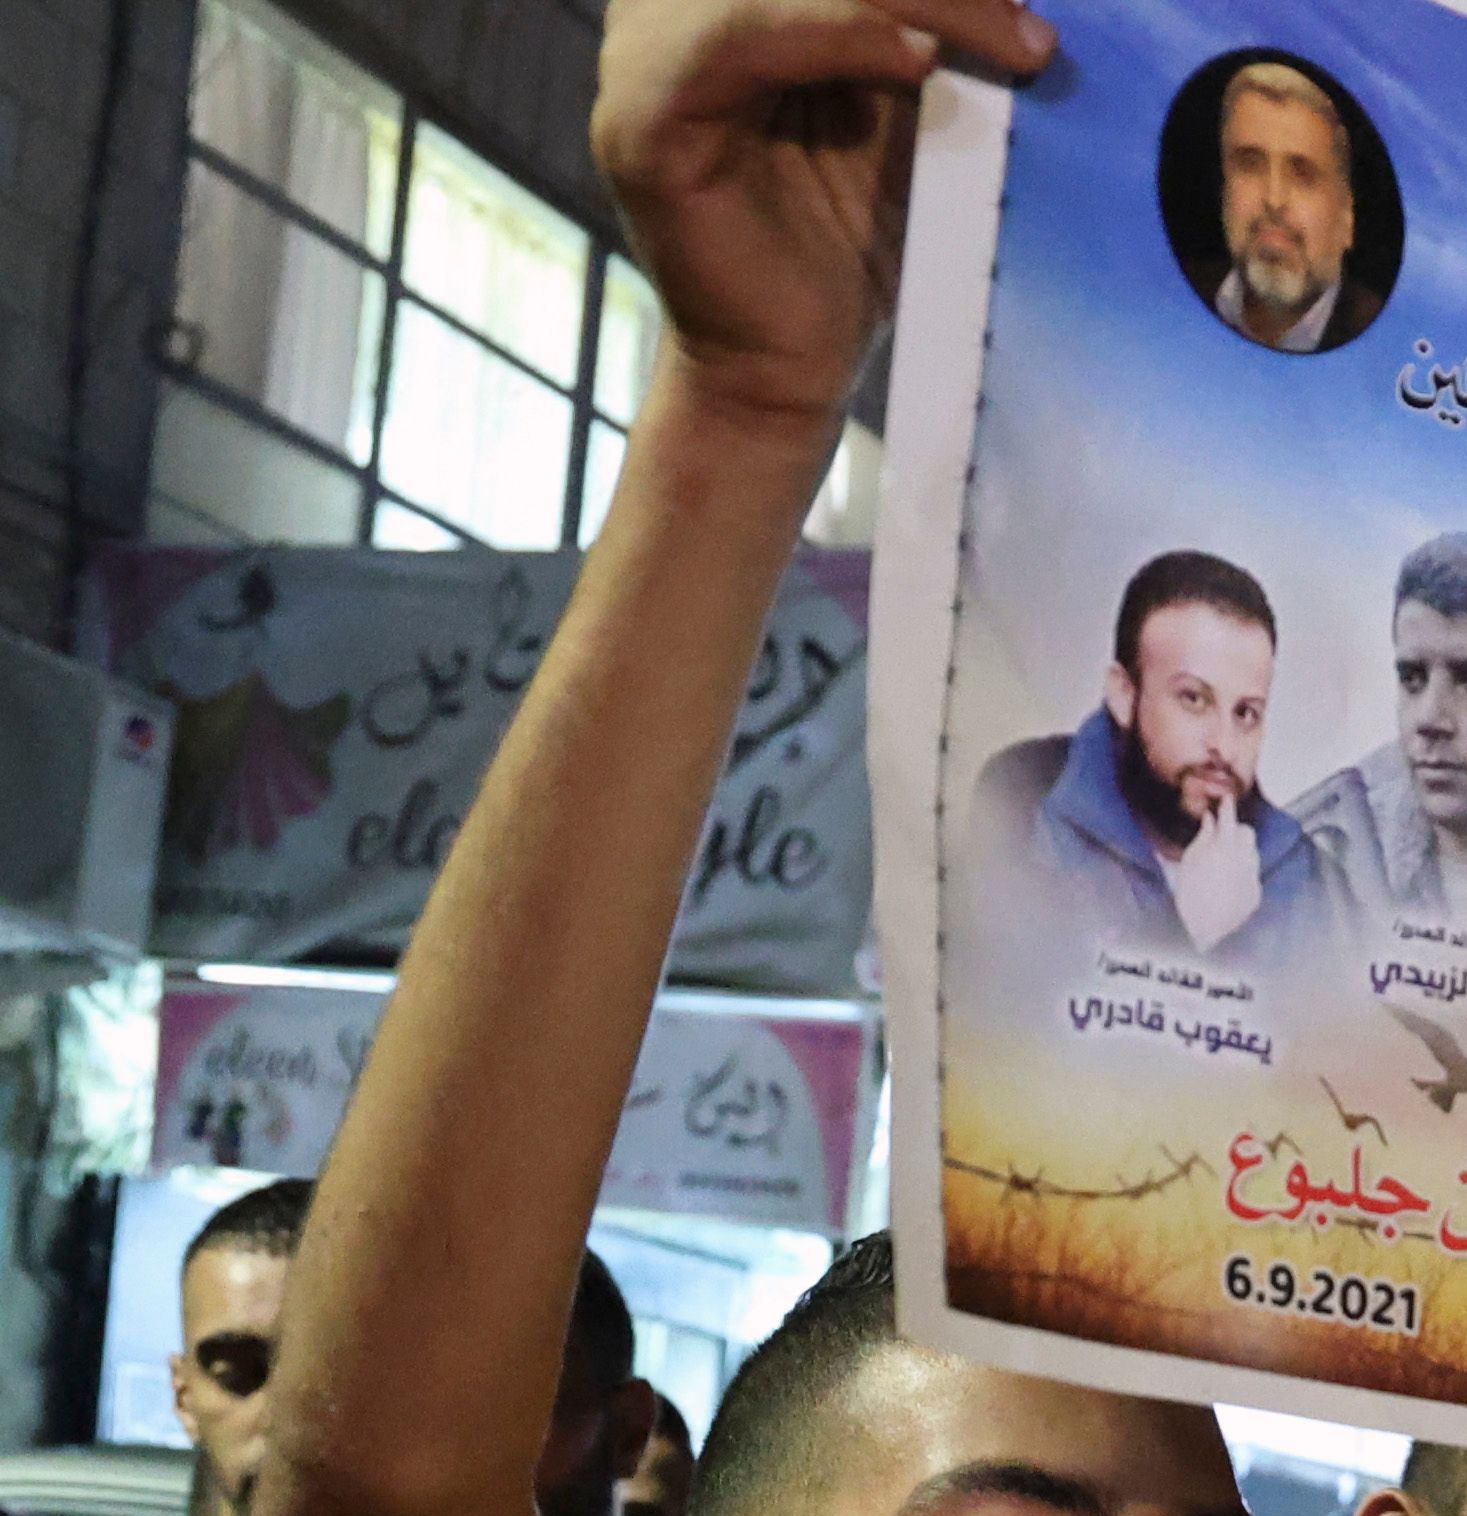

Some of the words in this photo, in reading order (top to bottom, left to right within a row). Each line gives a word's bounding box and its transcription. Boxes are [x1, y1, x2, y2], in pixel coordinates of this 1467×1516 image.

[1070, 998, 1164, 1031] قادري
[1175, 1018, 1272, 1065] يعقوب
[1225, 1131, 1430, 1239] جلبوع
[1225, 1258, 1416, 1331] 6.9.2021
